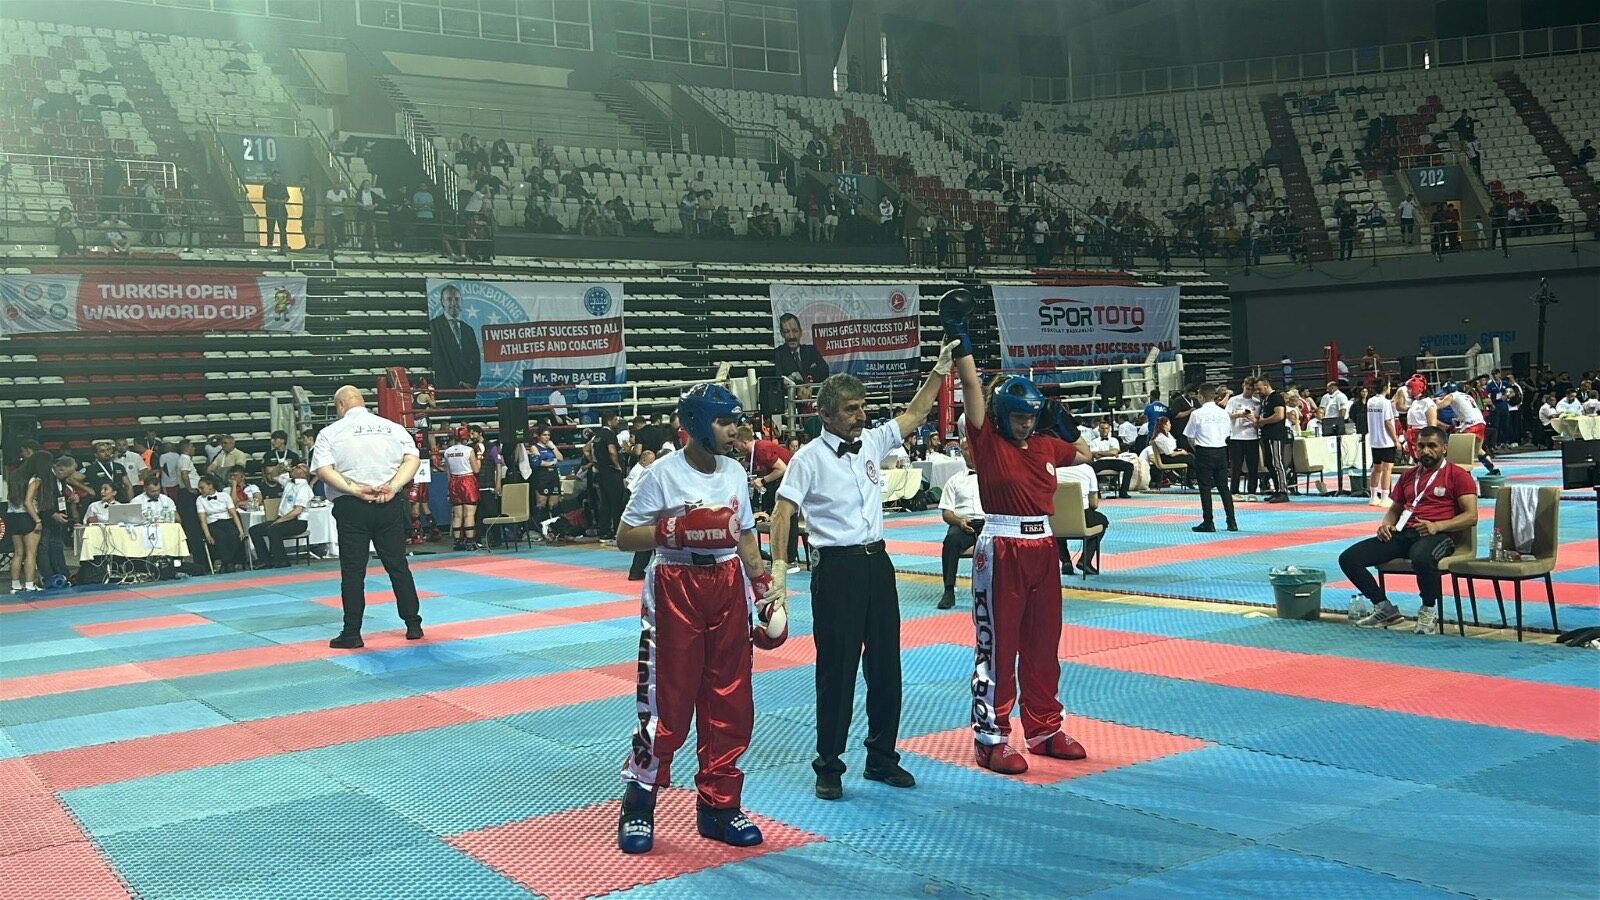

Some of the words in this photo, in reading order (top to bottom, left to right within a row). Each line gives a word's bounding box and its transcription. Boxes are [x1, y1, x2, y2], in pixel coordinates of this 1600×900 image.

[243, 138, 276, 161] 210
[1420, 169, 1445, 187] 202
[97, 284, 183, 299] TURKISH
[187, 285, 238, 299] OPEN
[461, 282, 522, 320] KICKBOXING
[82, 304, 145, 320] WAKO
[149, 305, 217, 320] WORLD
[220, 304, 258, 320] CUP
[485, 329, 489, 341] I
[491, 327, 517, 340] WISH
[518, 326, 547, 339] GREAT
[549, 324, 588, 337] SUCCESS
[590, 323, 602, 335] TO
[603, 322, 619, 334] ALL
[814, 328, 818, 338] I
[818, 326, 839, 338] WISH
[839, 324, 861, 336] GREAT
[862, 322, 892, 333] SUCCESS
[893, 322, 903, 332] TO
[904, 320, 916, 330] ALL
[500, 340, 546, 355] ATHLETES
[547, 339, 566, 352] AND
[568, 338, 609, 351] COACHES
[825, 337, 860, 350] ATHLETES
[861, 336, 876, 347] AND
[877, 334, 908, 346] COACHES
[1007, 344, 1025, 357] WE
[1026, 344, 1056, 357] WISH
[1058, 343, 1094, 356] GREAT
[1095, 342, 1140, 354] SUCCESS
[1157, 340, 1173, 352] ALL
[533, 373, 549, 383] Mr.
[551, 373, 570, 384] Roy
[572, 372, 607, 382] BAKER
[419, 468, 426, 476] 4
[148, 533, 156, 541] 4
[685, 529, 705, 540] TOP
[705, 528, 728, 540] TEN
[974, 589, 993, 671] KICK
